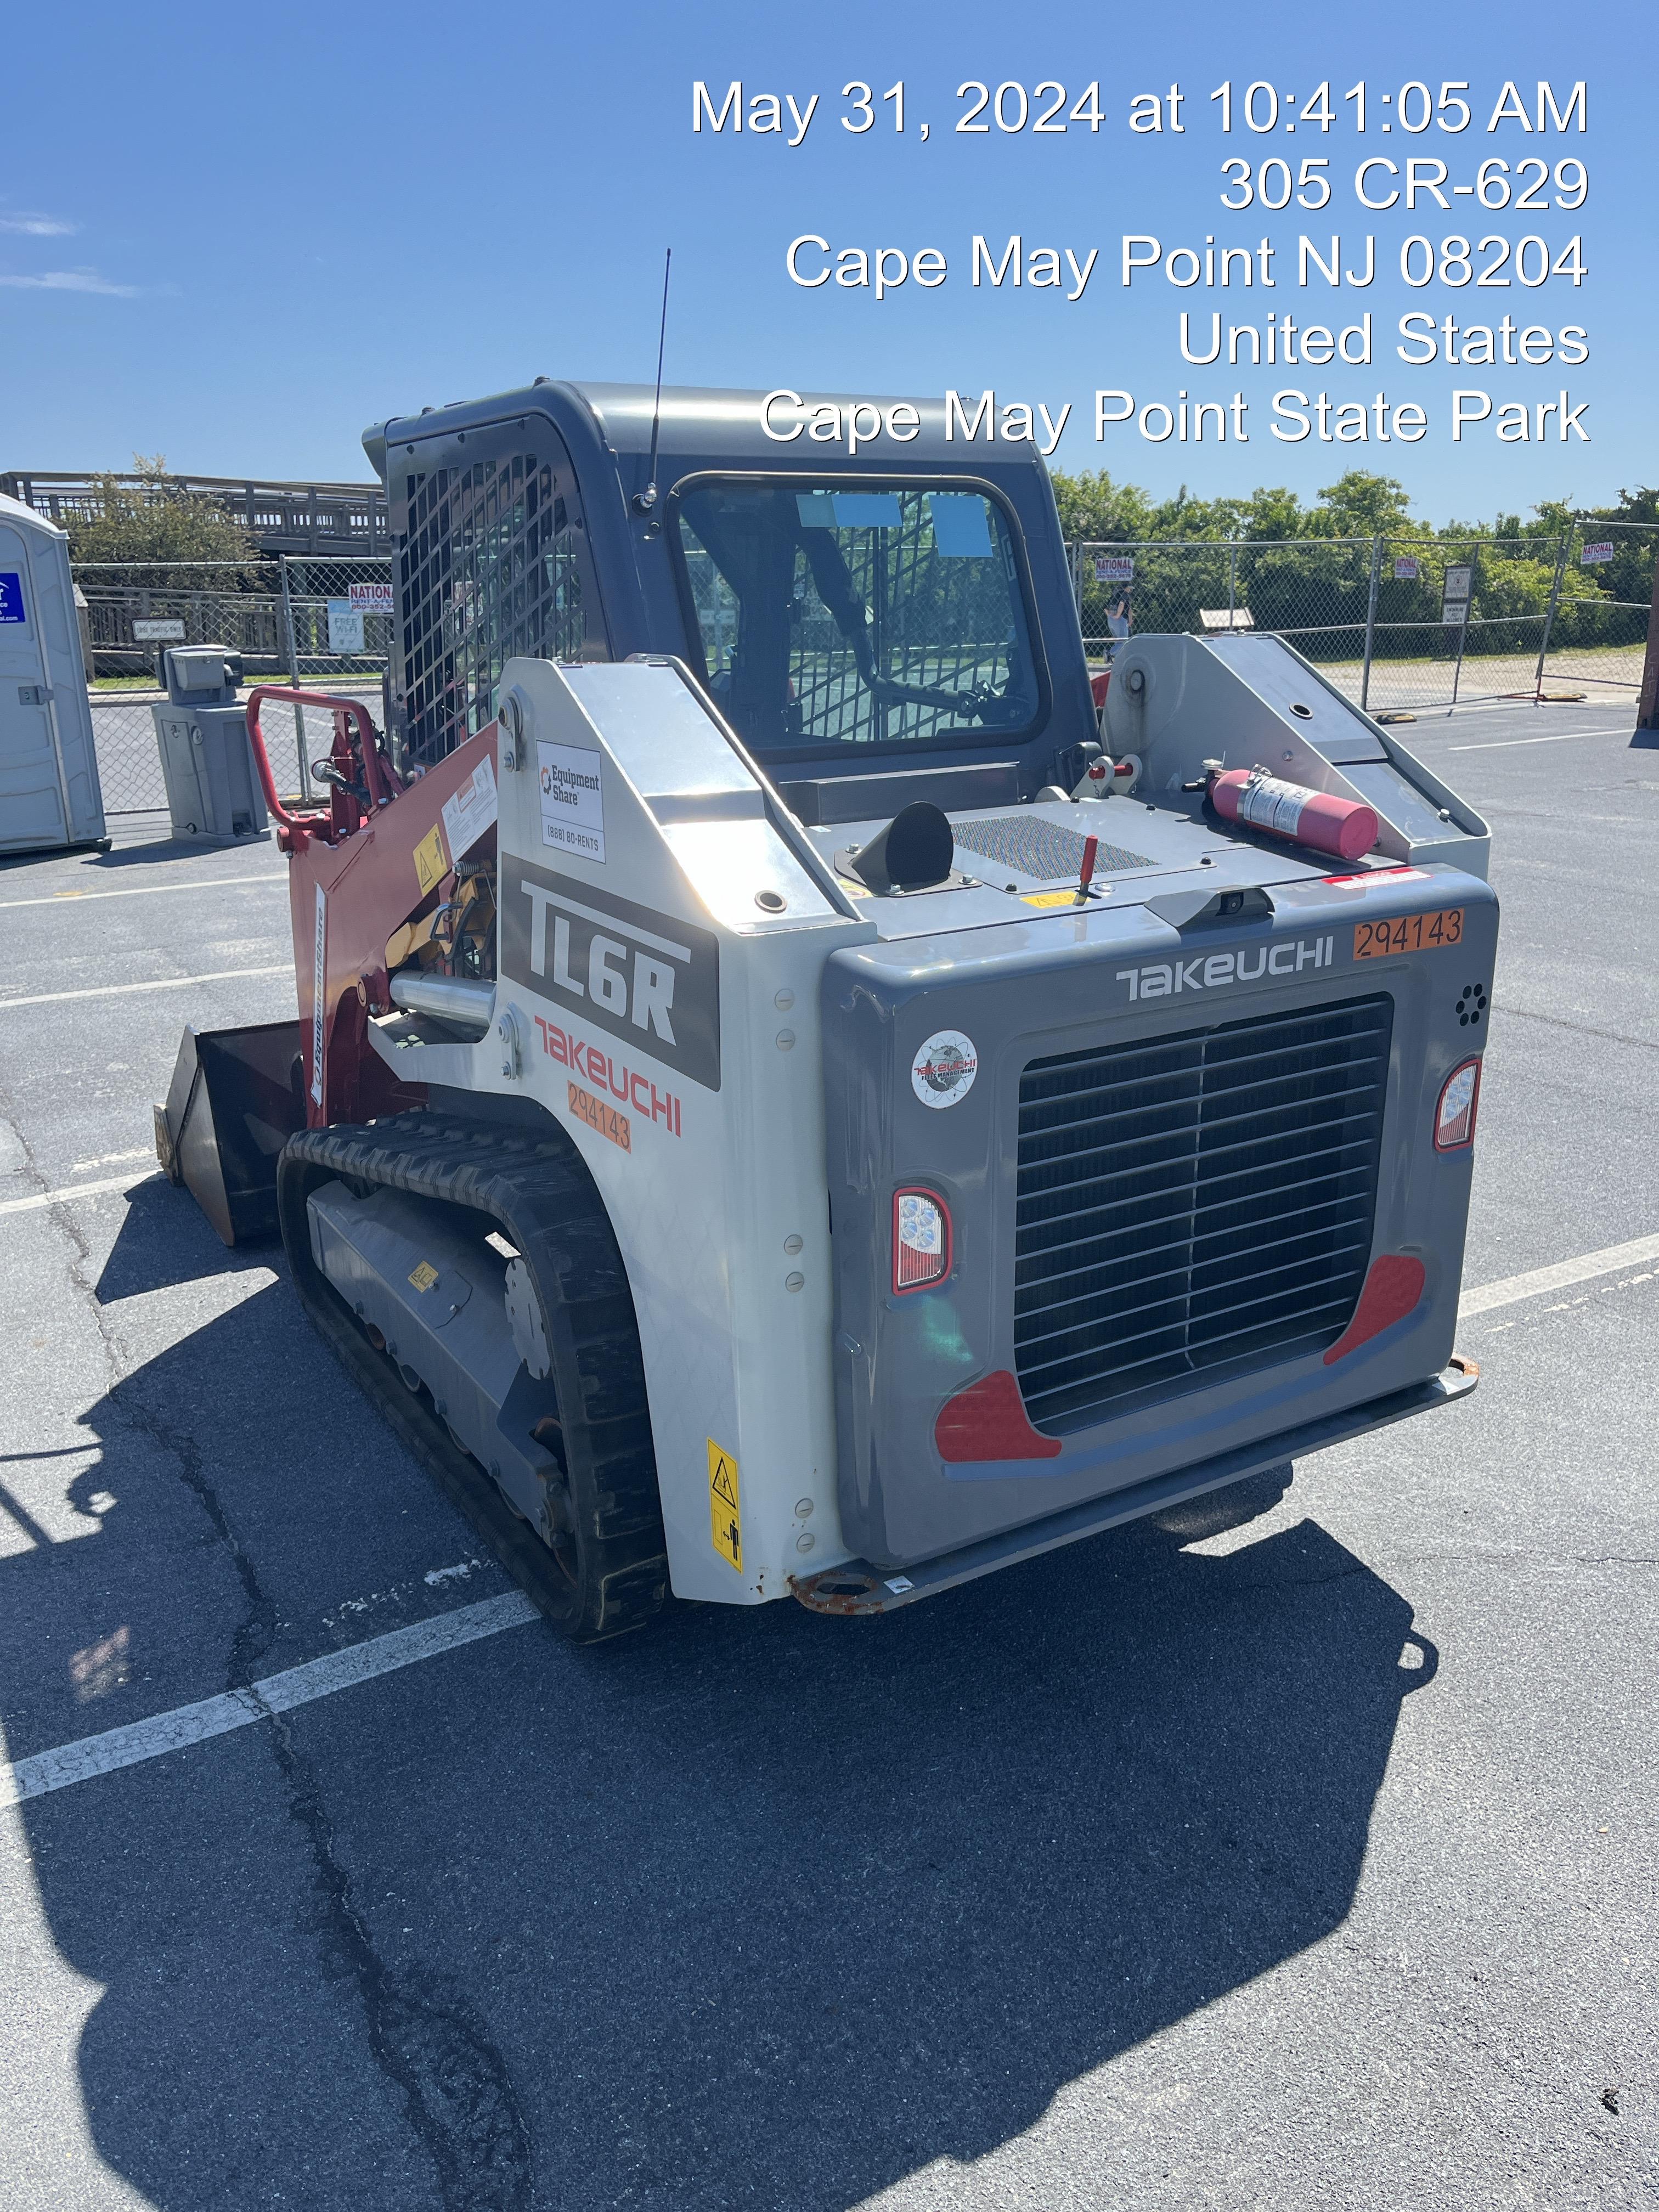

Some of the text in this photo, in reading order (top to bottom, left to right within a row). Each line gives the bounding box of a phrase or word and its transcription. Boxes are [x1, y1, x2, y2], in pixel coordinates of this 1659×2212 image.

[1583, 543, 1613, 555] NATIONAL
[1097, 559, 1132, 569] NATIONAL
[351, 585, 393, 599] NATION
[551, 764, 600, 791] Equipment
[552, 785, 578, 806] Share
[548, 825, 599, 851] (888) 80-RENTS
[1356, 909, 1462, 957] 294143
[521, 879, 692, 1047] TL6R
[315, 907, 323, 1067] EquipmentShare
[937, 1068, 975, 1079] MANAGEMENT
[568, 1082, 630, 1150] 294143
